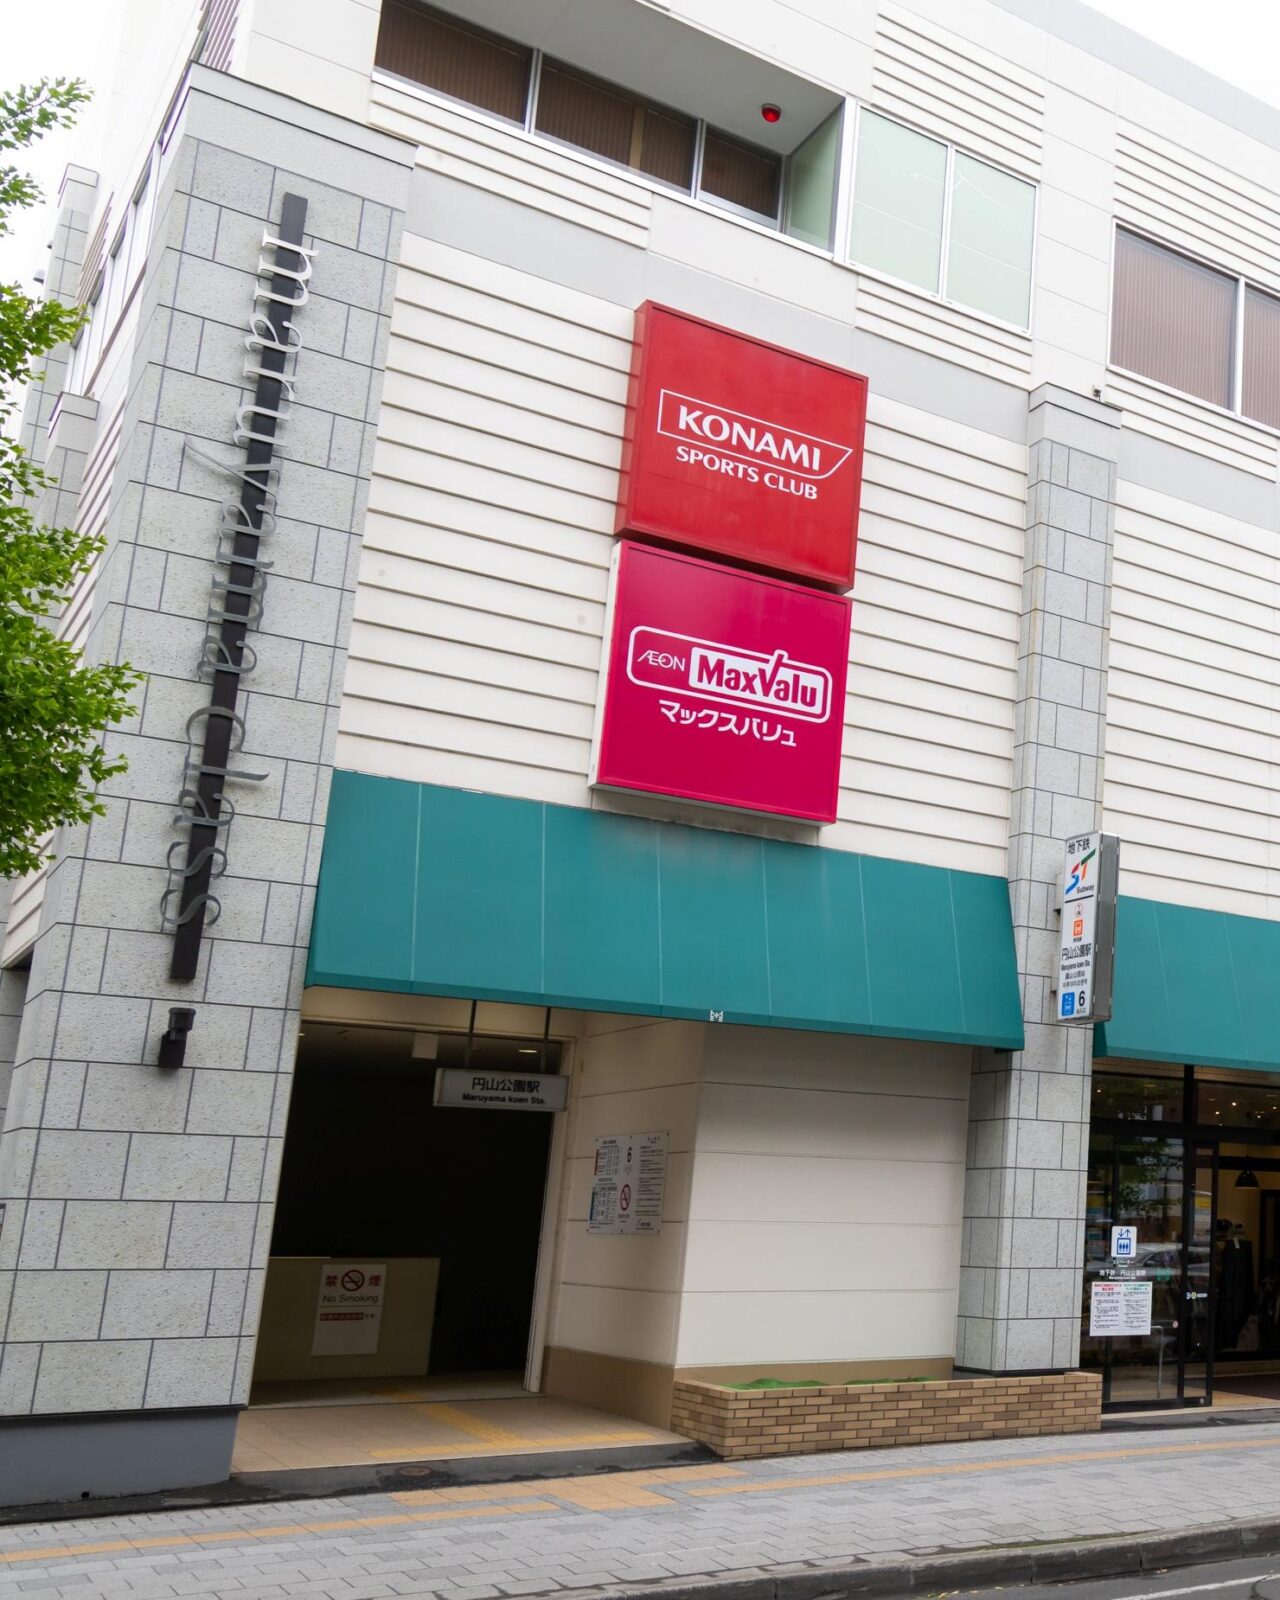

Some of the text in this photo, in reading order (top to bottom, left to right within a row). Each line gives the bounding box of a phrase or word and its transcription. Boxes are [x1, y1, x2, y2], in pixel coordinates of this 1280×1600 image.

[677, 404, 822, 471] KONAMI
[675, 444, 818, 500] SPORTS CLUB
[696, 649, 818, 708] MaxValu
[658, 699, 798, 748] マックスバリュ
[1068, 837, 1090, 855] 地下鉄
[1076, 884, 1095, 894] Subway
[1061, 943, 1092, 960] 円山公園駅
[1078, 990, 1086, 1007] 6
[471, 1077, 540, 1093] 円山公園駅
[462, 1092, 507, 1103] Maruyama
[508, 1095, 529, 1103] koen
[322, 1294, 379, 1304] No Smoking
